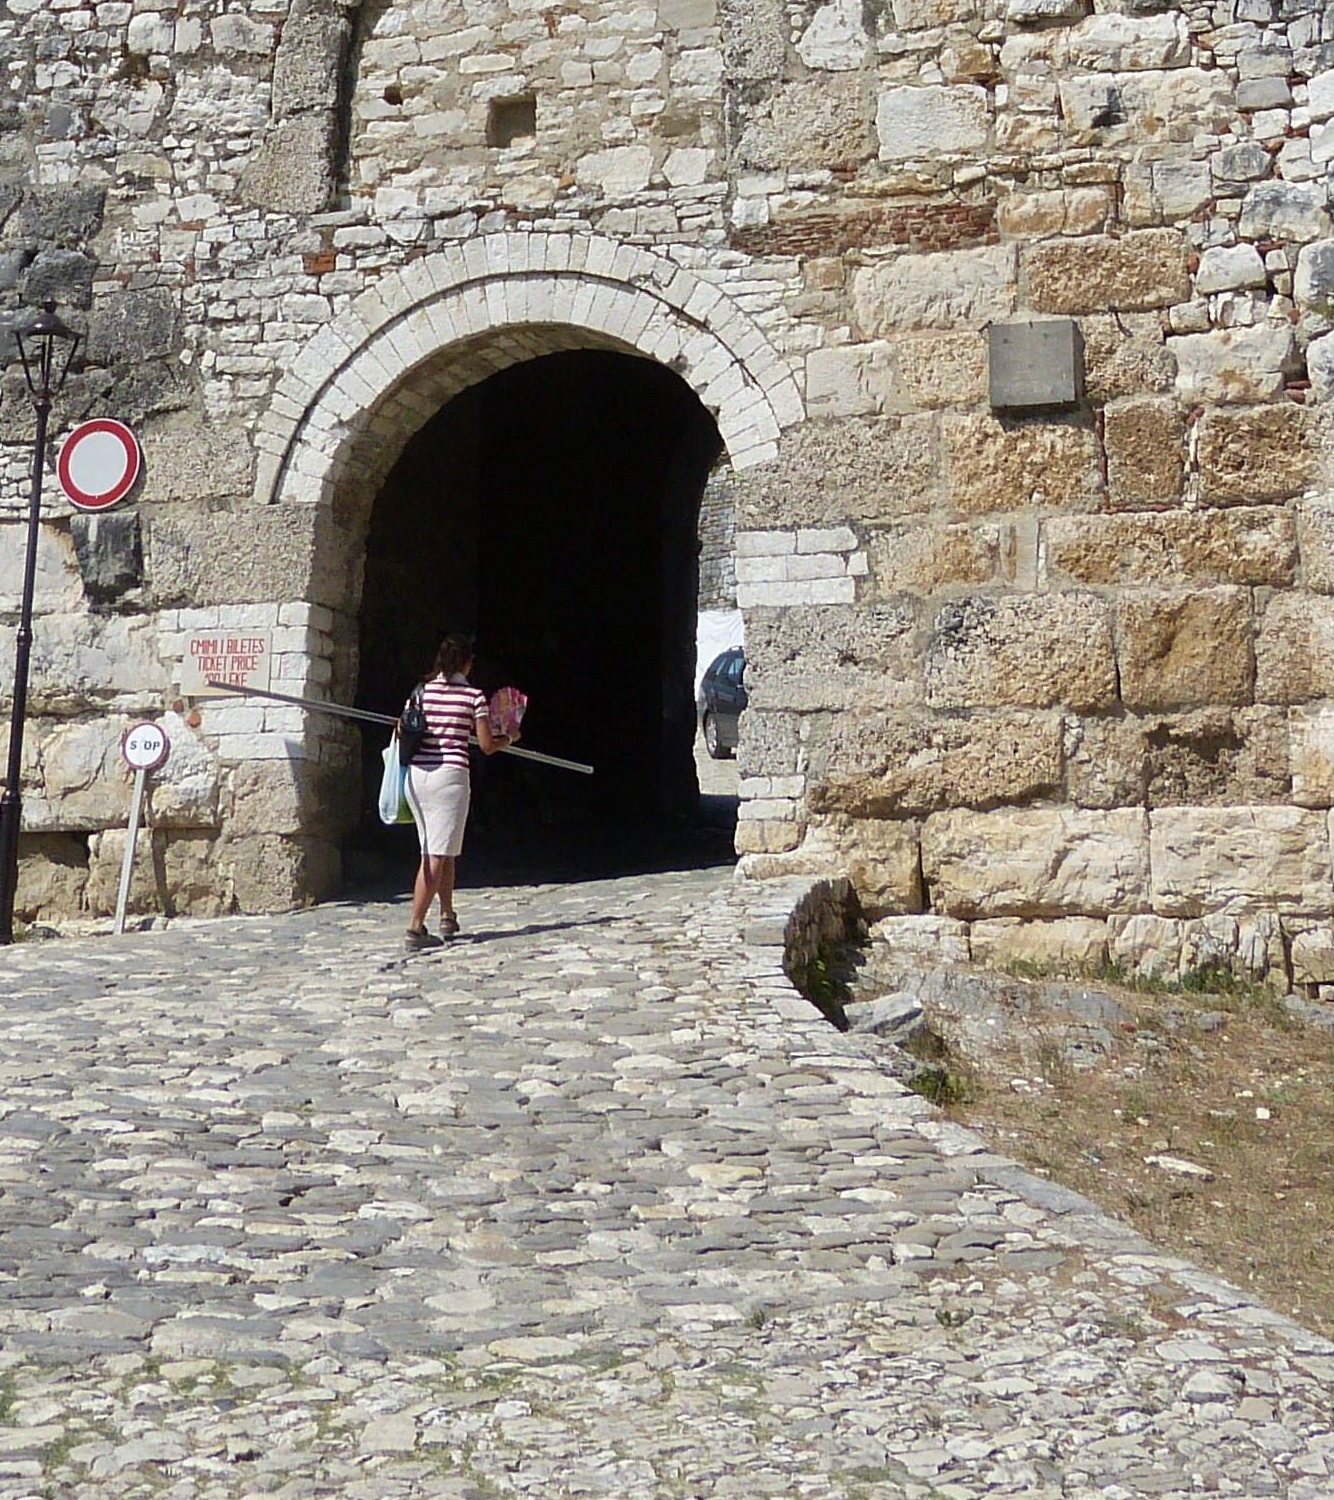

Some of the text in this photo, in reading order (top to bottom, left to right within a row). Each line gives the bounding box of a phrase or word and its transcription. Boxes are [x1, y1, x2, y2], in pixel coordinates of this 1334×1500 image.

[227, 638, 265, 654] BILETES
[198, 655, 259, 672] TICKET PRICE
[130, 740, 161, 751] SOP
